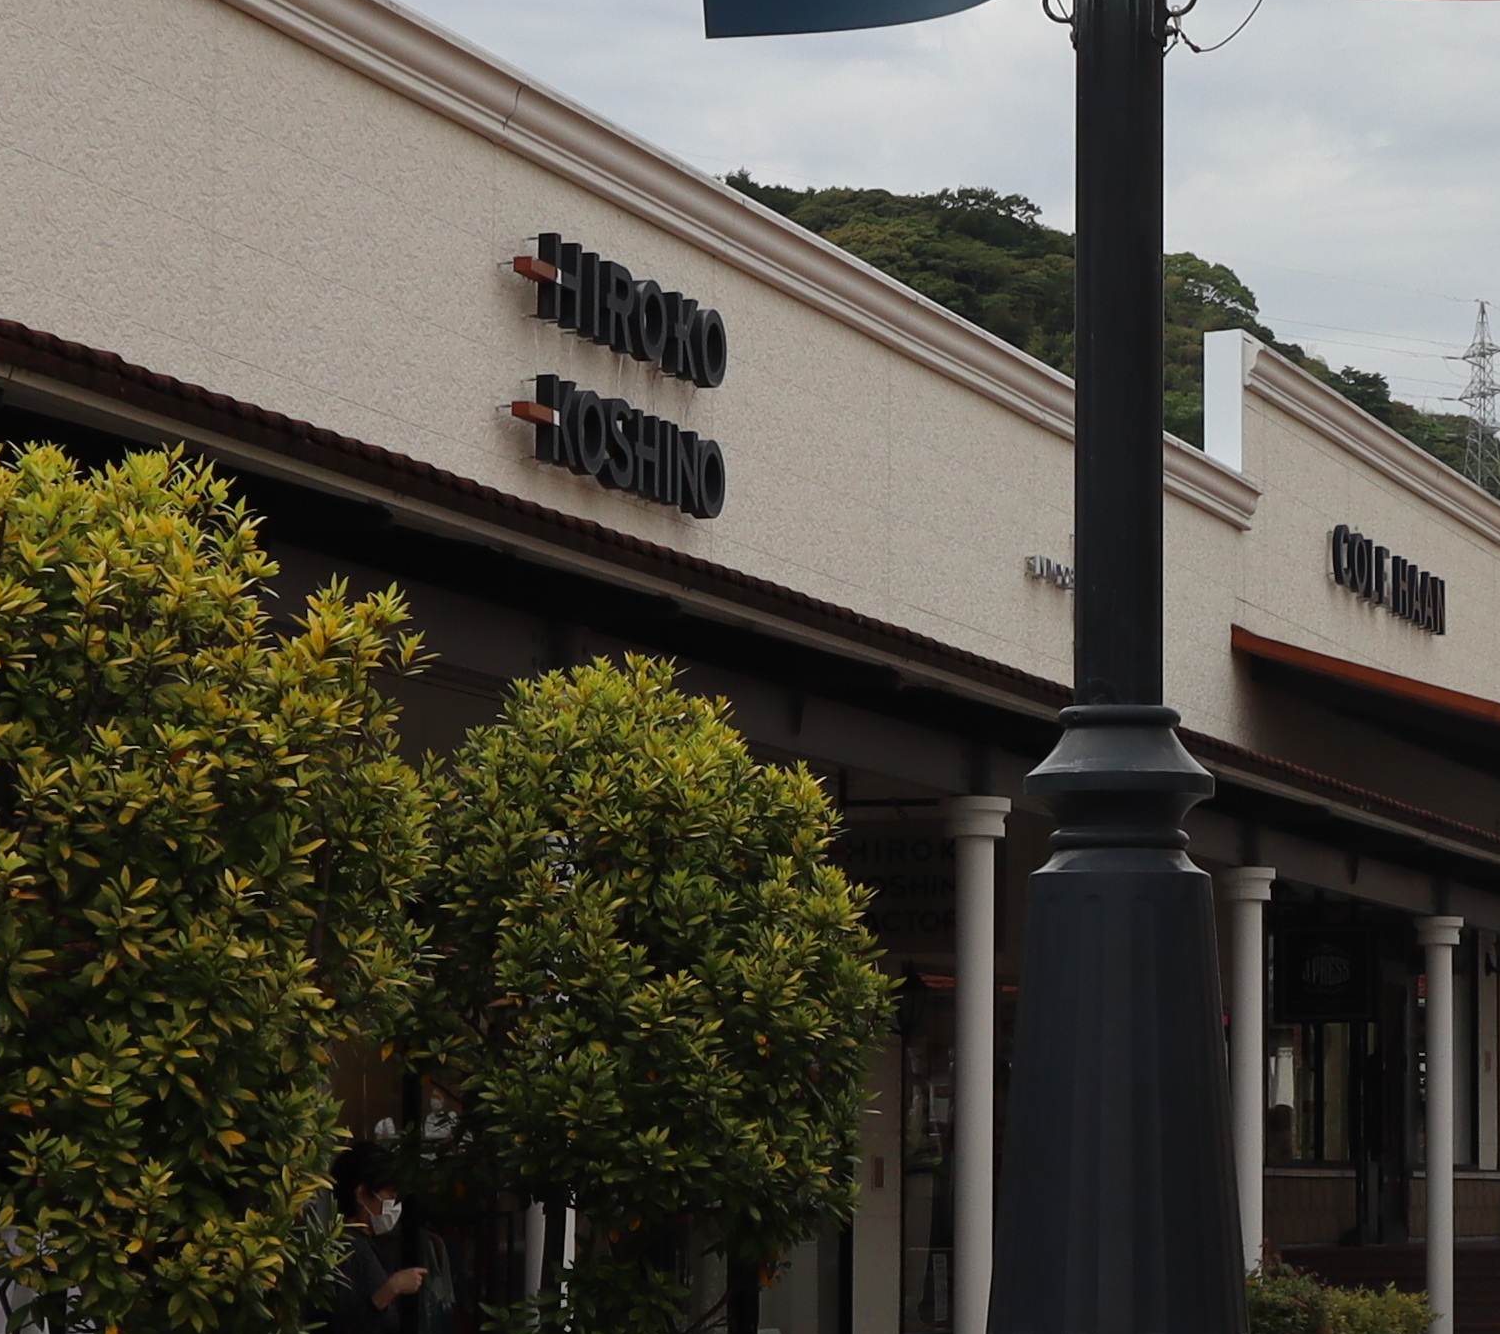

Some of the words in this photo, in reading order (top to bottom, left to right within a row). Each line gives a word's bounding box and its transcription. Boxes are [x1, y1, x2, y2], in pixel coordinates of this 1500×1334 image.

[536, 232, 728, 388] HIROKO
[534, 374, 726, 519] KOSHINO
[1332, 524, 1392, 607] COLE
[1392, 555, 1446, 636] HAAN
[847, 839, 955, 862] HIROK
